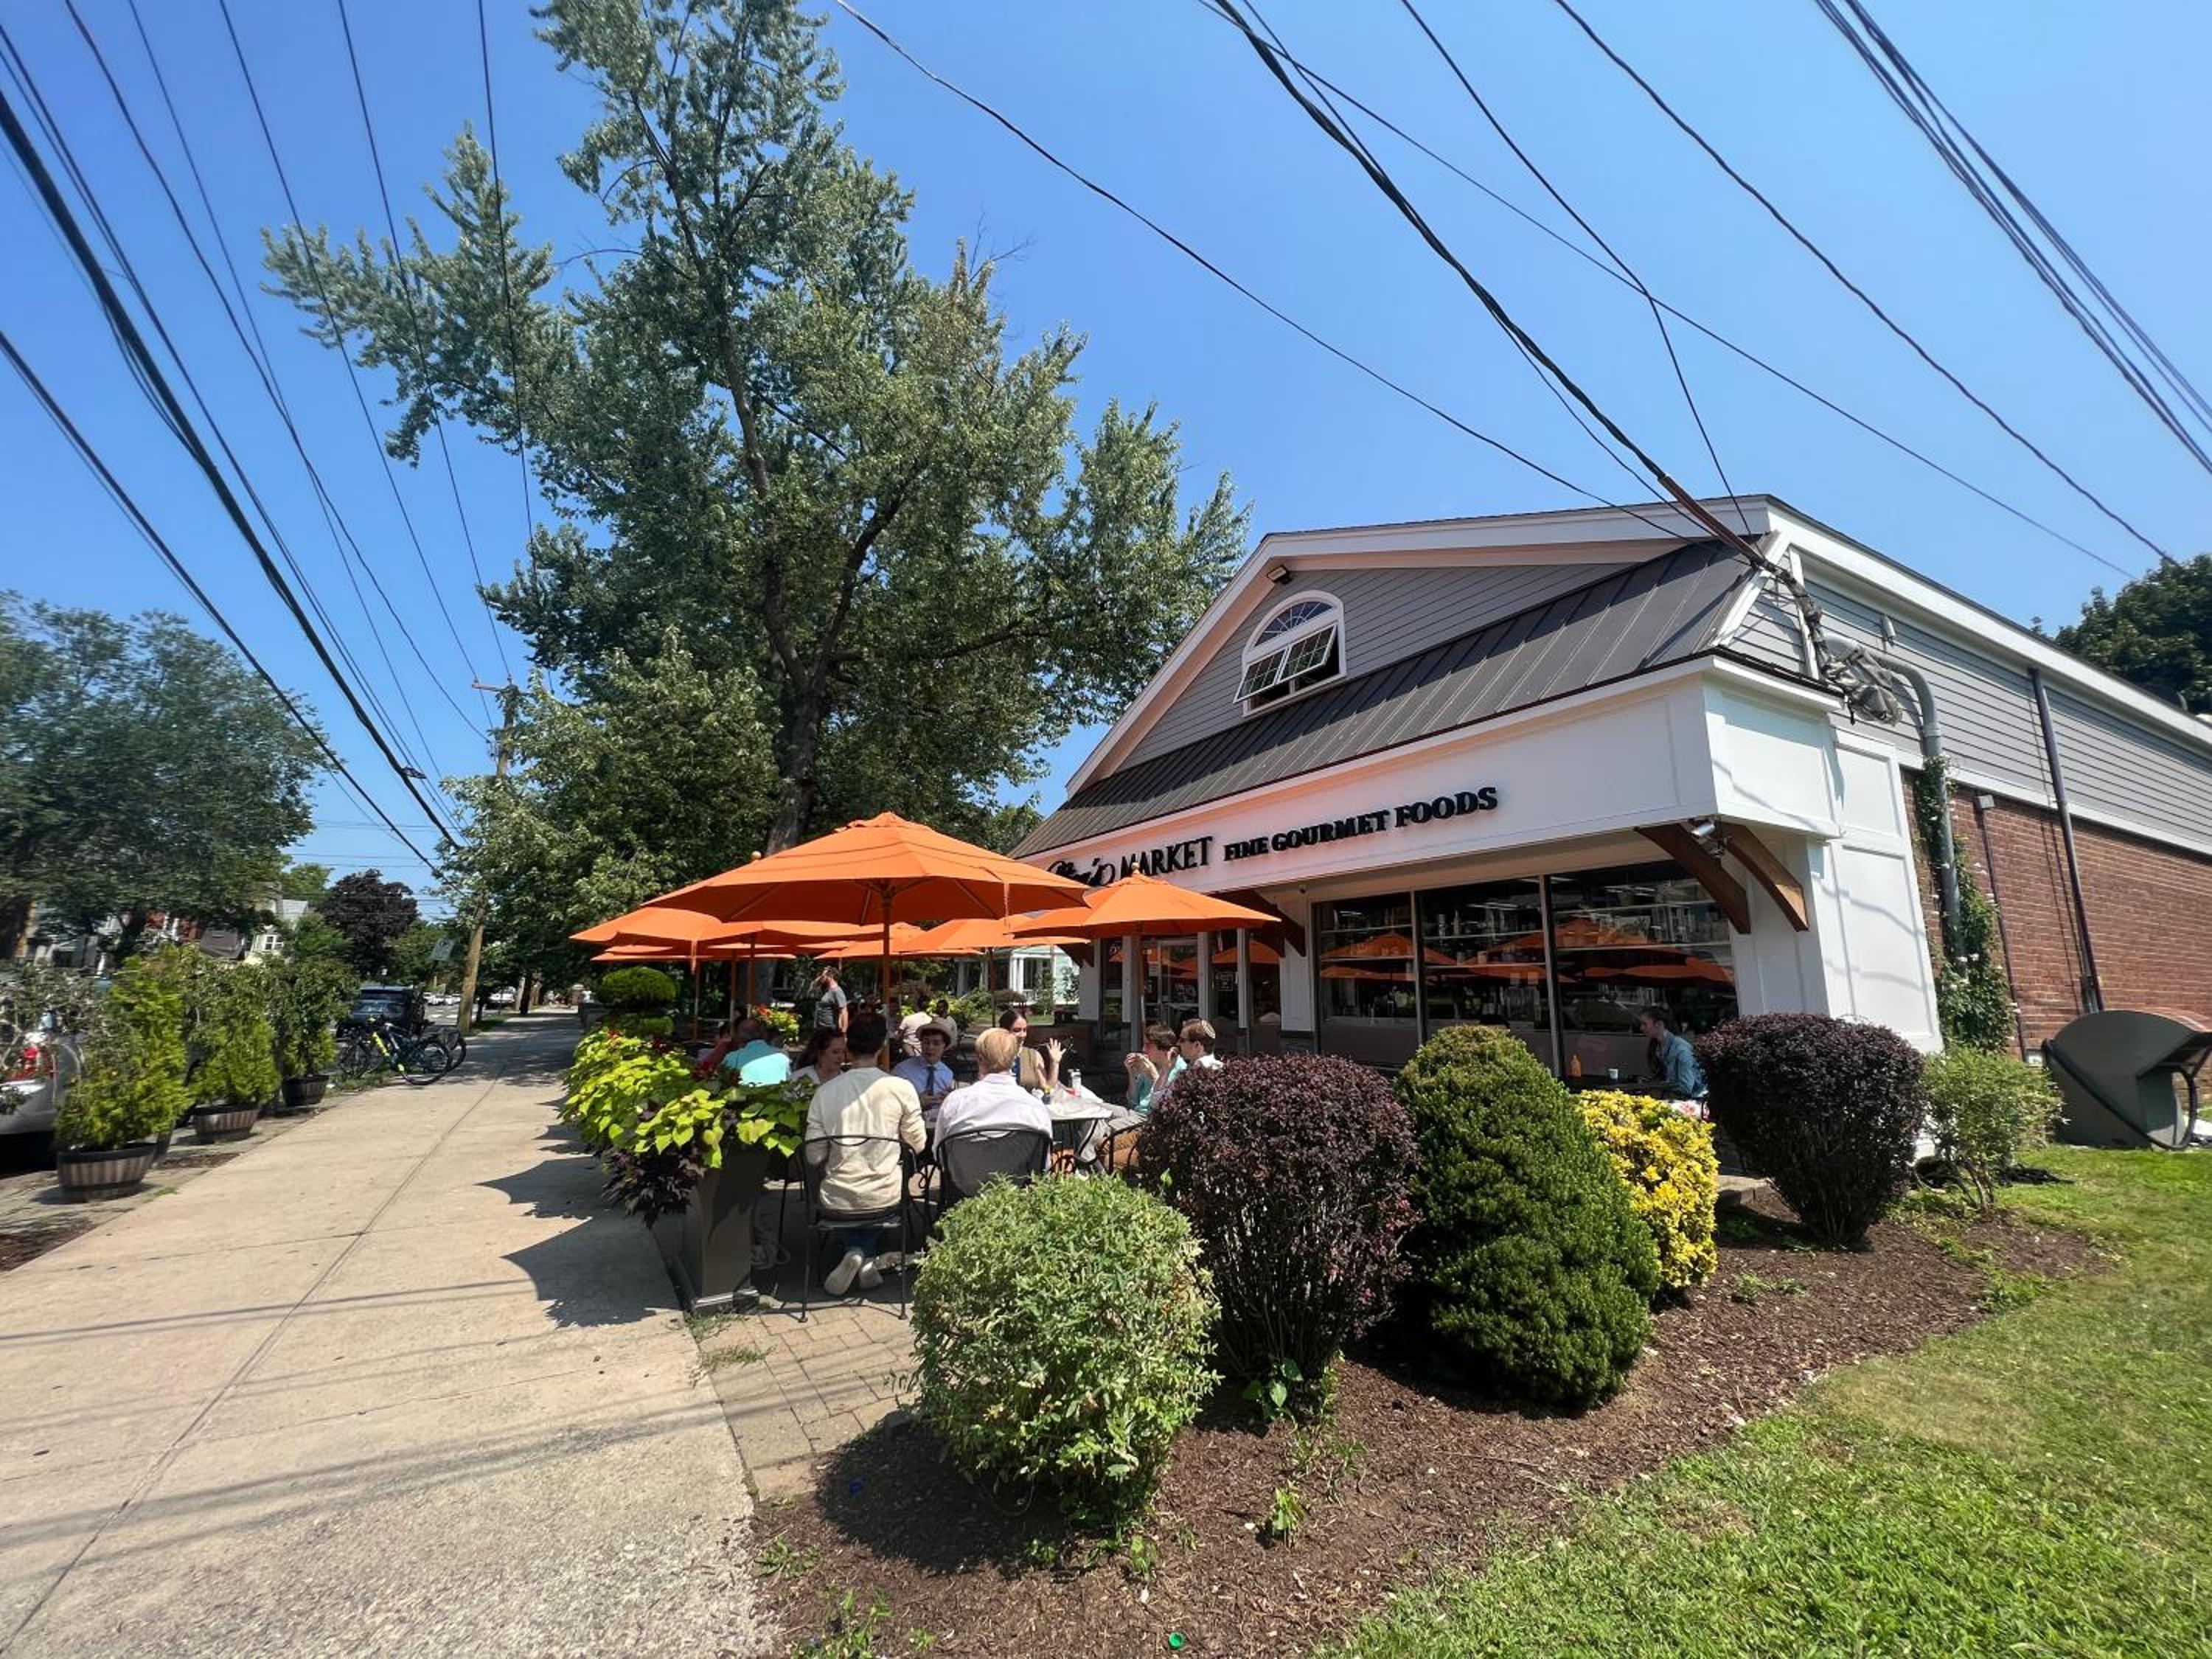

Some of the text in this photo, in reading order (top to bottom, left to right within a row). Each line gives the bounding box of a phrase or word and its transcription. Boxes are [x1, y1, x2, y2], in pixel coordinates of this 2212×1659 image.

[1120, 835, 1213, 880] MARKET
[1223, 836, 1269, 862] FINE
[1271, 809, 1391, 852] GOURMET
[1394, 786, 1499, 828] FOODS
